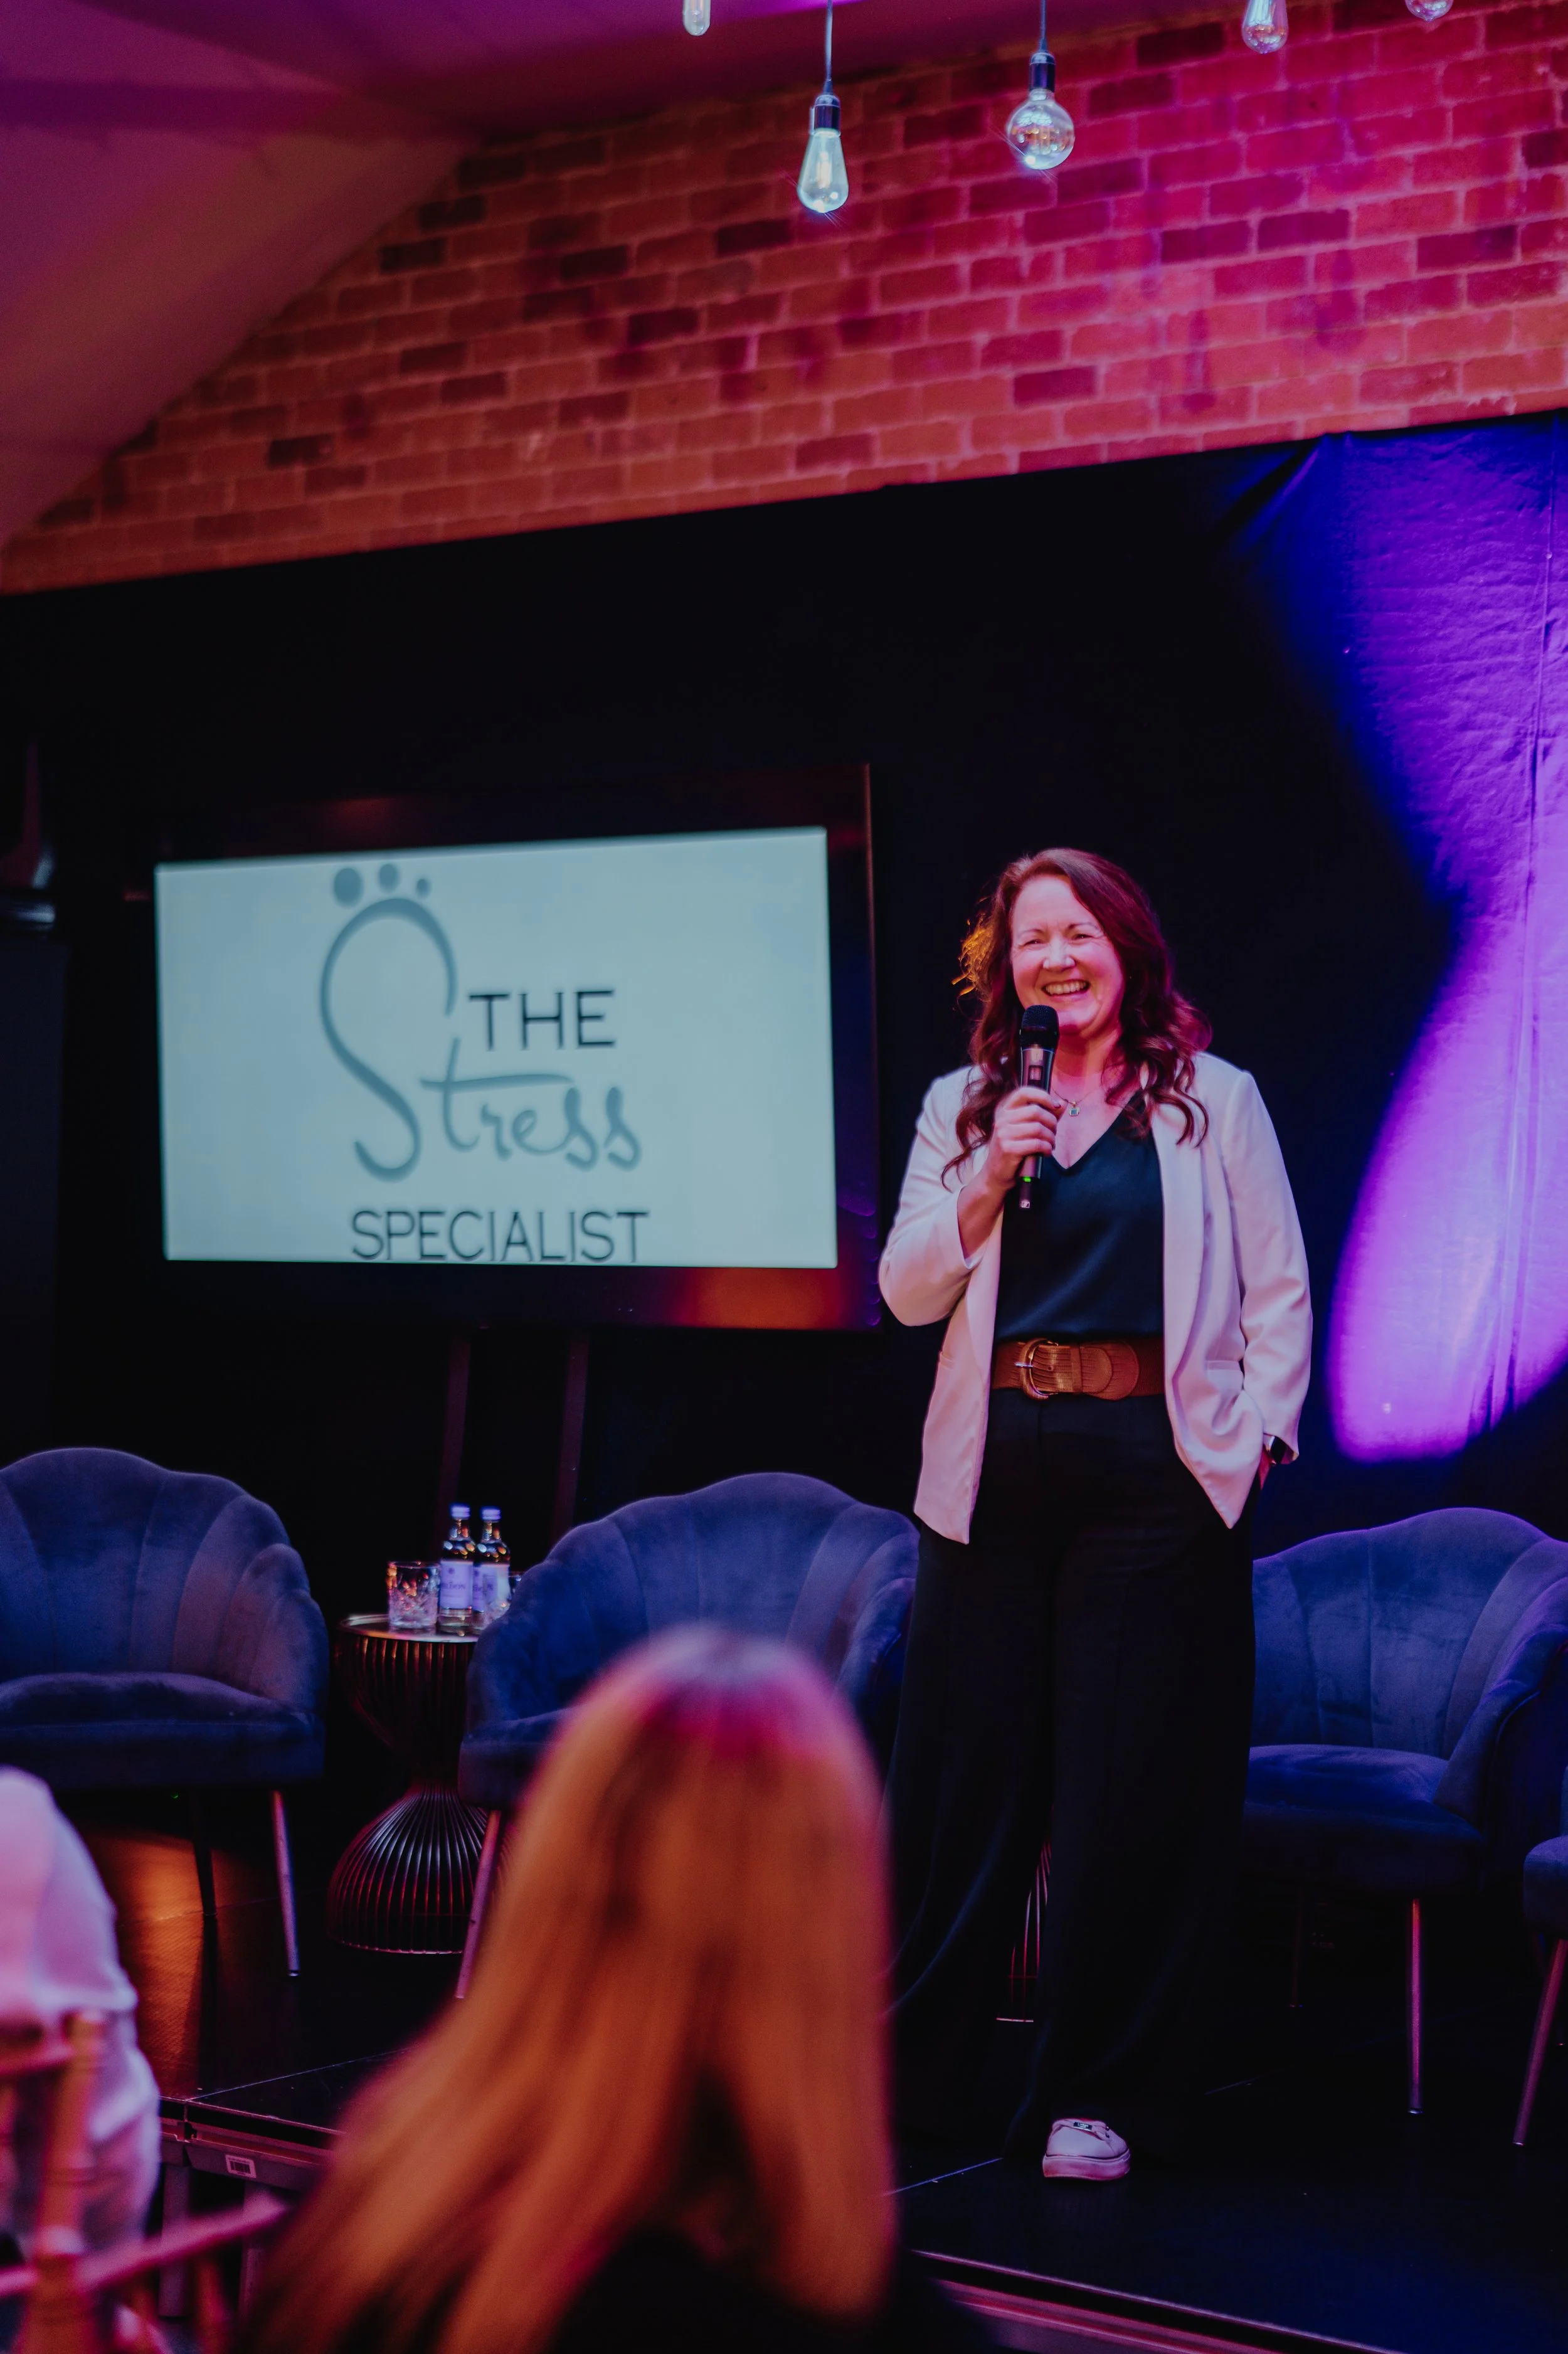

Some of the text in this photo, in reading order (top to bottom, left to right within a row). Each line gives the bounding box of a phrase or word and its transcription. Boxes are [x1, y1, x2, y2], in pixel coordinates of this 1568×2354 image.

[319, 897, 642, 1183] Stress
[467, 989, 616, 1051] THE
[352, 1210, 650, 1263] SPECIALIST
